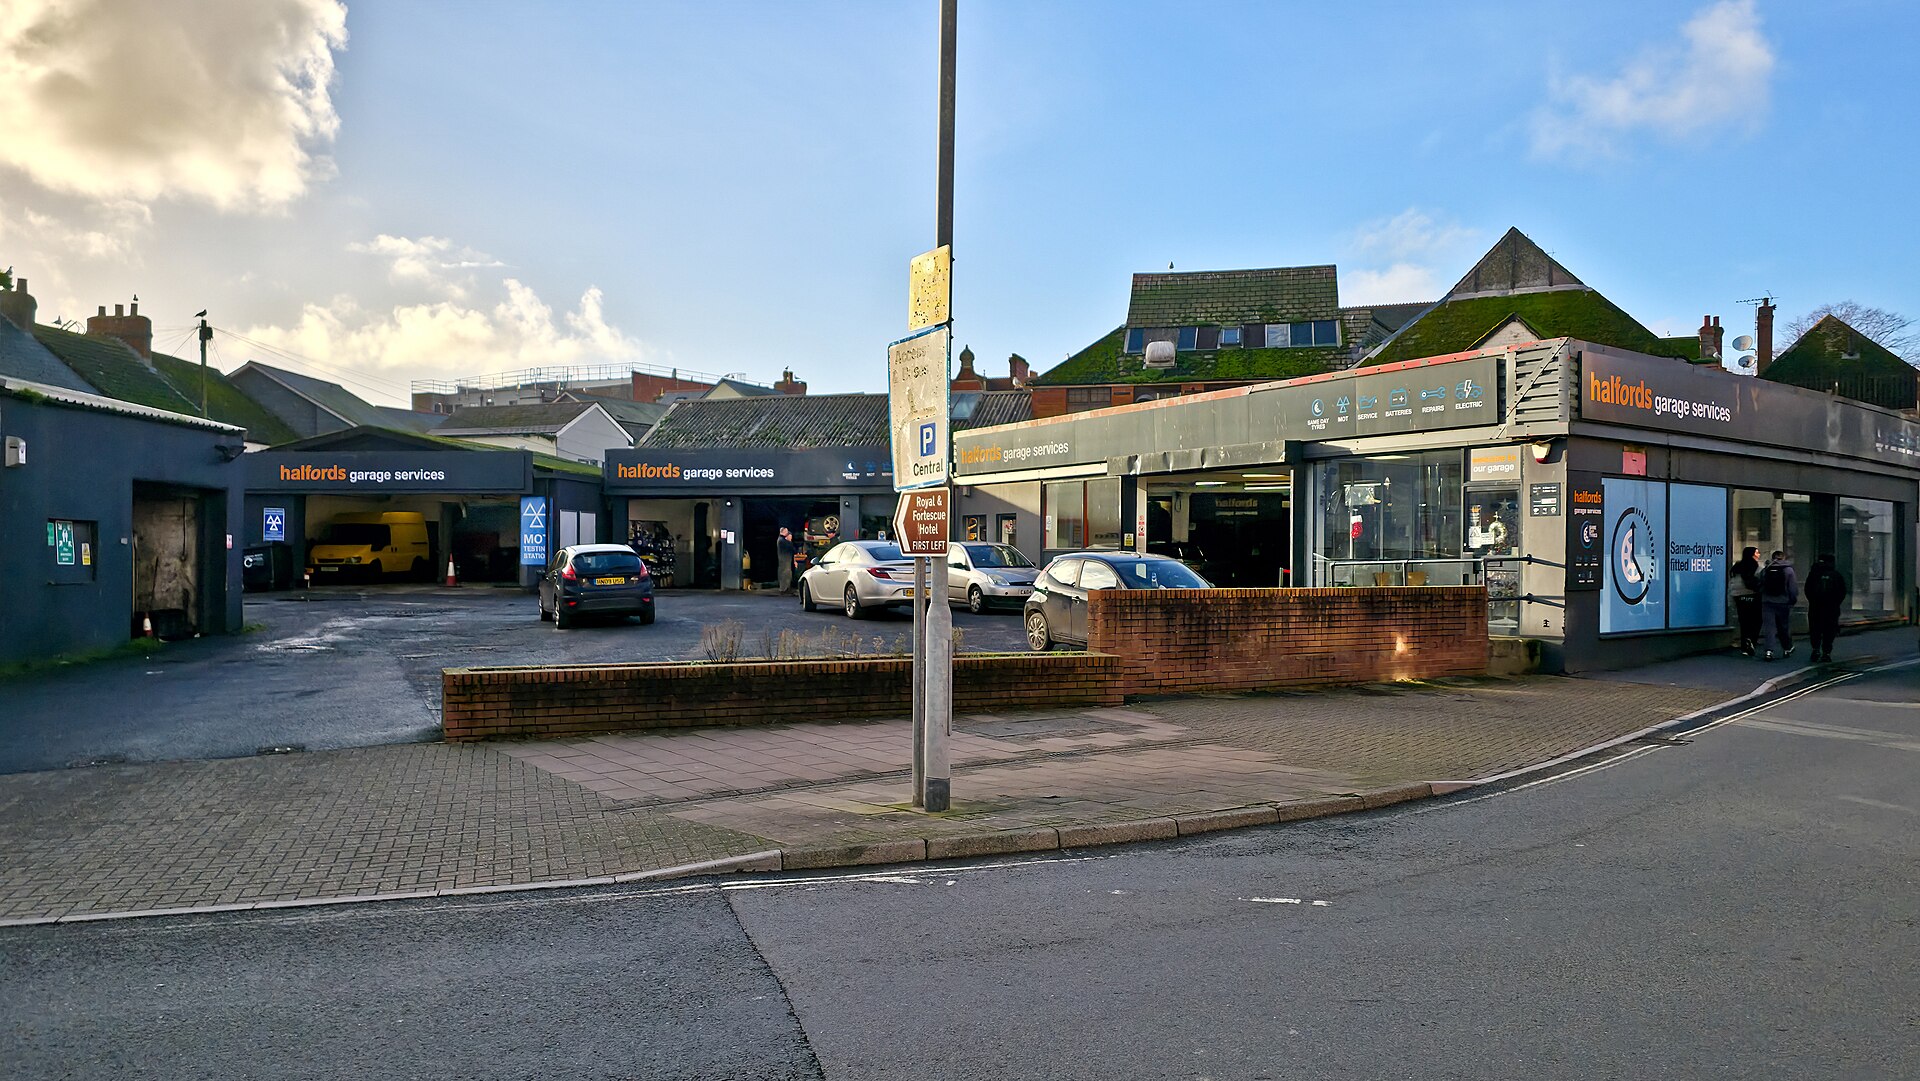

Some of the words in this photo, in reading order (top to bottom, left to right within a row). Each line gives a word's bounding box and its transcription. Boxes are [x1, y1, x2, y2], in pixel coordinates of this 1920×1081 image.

[1590, 371, 1653, 410] halfords
[1655, 395, 1690, 419] garage
[1692, 401, 1731, 422] services
[1421, 405, 1445, 413] REPAIRS
[1455, 401, 1483, 410] ELECTRIC
[1357, 412, 1378, 420] SERVICE
[1385, 409, 1412, 417] BATTERIES
[961, 443, 1001, 464] halfords
[1003, 447, 1031, 462] garage
[1033, 441, 1069, 456] services
[280, 464, 347, 480] halfords
[350, 470, 391, 483] garage
[394, 469, 445, 480] services
[617, 463, 681, 478] halfords
[683, 468, 723, 480] garage
[725, 467, 775, 478] services
[913, 458, 944, 477] Central
[1473, 464, 1486, 472] our
[1487, 463, 1515, 474] garage
[916, 495, 936, 508] Royal
[936, 495, 943, 506] &
[1574, 490, 1602, 503] halfords
[912, 510, 946, 521] Fortescue
[919, 523, 939, 535] Hotel
[523, 533, 546, 545] MO
[912, 541, 930, 550] FIRST
[930, 540, 946, 550] LEFT
[1670, 541, 1706, 557] Same-day
[1707, 542, 1724, 557] tyres
[1670, 558, 1689, 571] fitted
